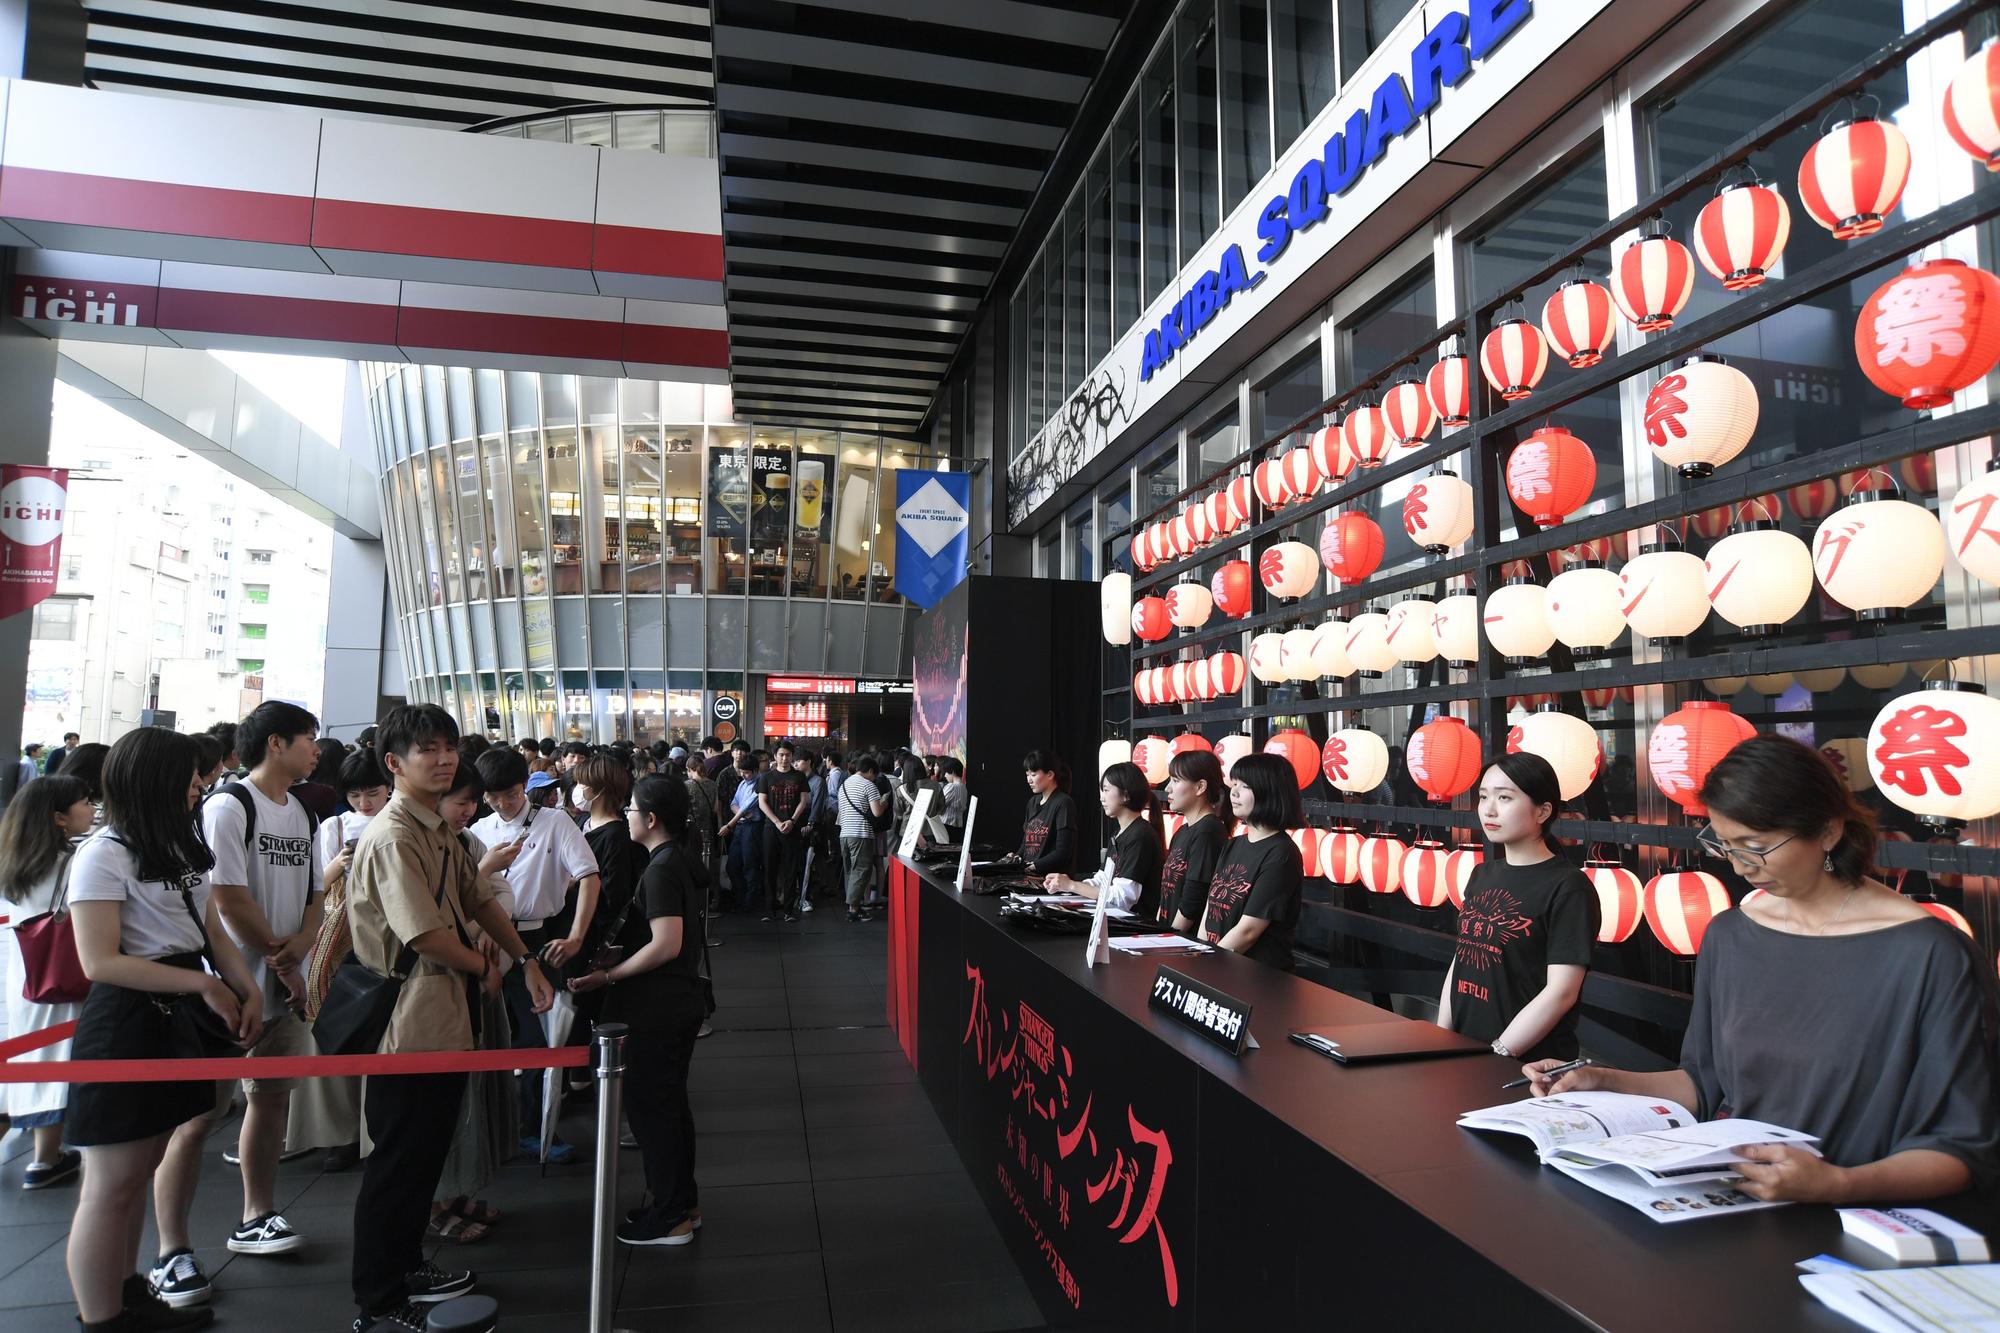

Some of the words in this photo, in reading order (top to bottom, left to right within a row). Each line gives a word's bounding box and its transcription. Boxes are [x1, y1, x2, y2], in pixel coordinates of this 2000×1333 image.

[24, 285, 116, 300] AKIBA
[22, 296, 138, 326] ICHI
[718, 454, 788, 471] 東京限定。
[3, 506, 62, 521] ICHI
[716, 703, 734, 712] CAFE
[1876, 704, 1971, 797] 祭
[258, 835, 312, 858] STRANGER
[269, 851, 305, 867] THINGS
[1460, 918, 1494, 940] 夏祭り
[1457, 979, 1489, 1002] NETFLIX
[1154, 975, 1243, 1041] ゲスト/関係者受付
[1019, 1003, 1055, 1062] STRANGER
[1024, 1033, 1048, 1075] THINGS
[1005, 1113, 1071, 1231] 未知の世界
